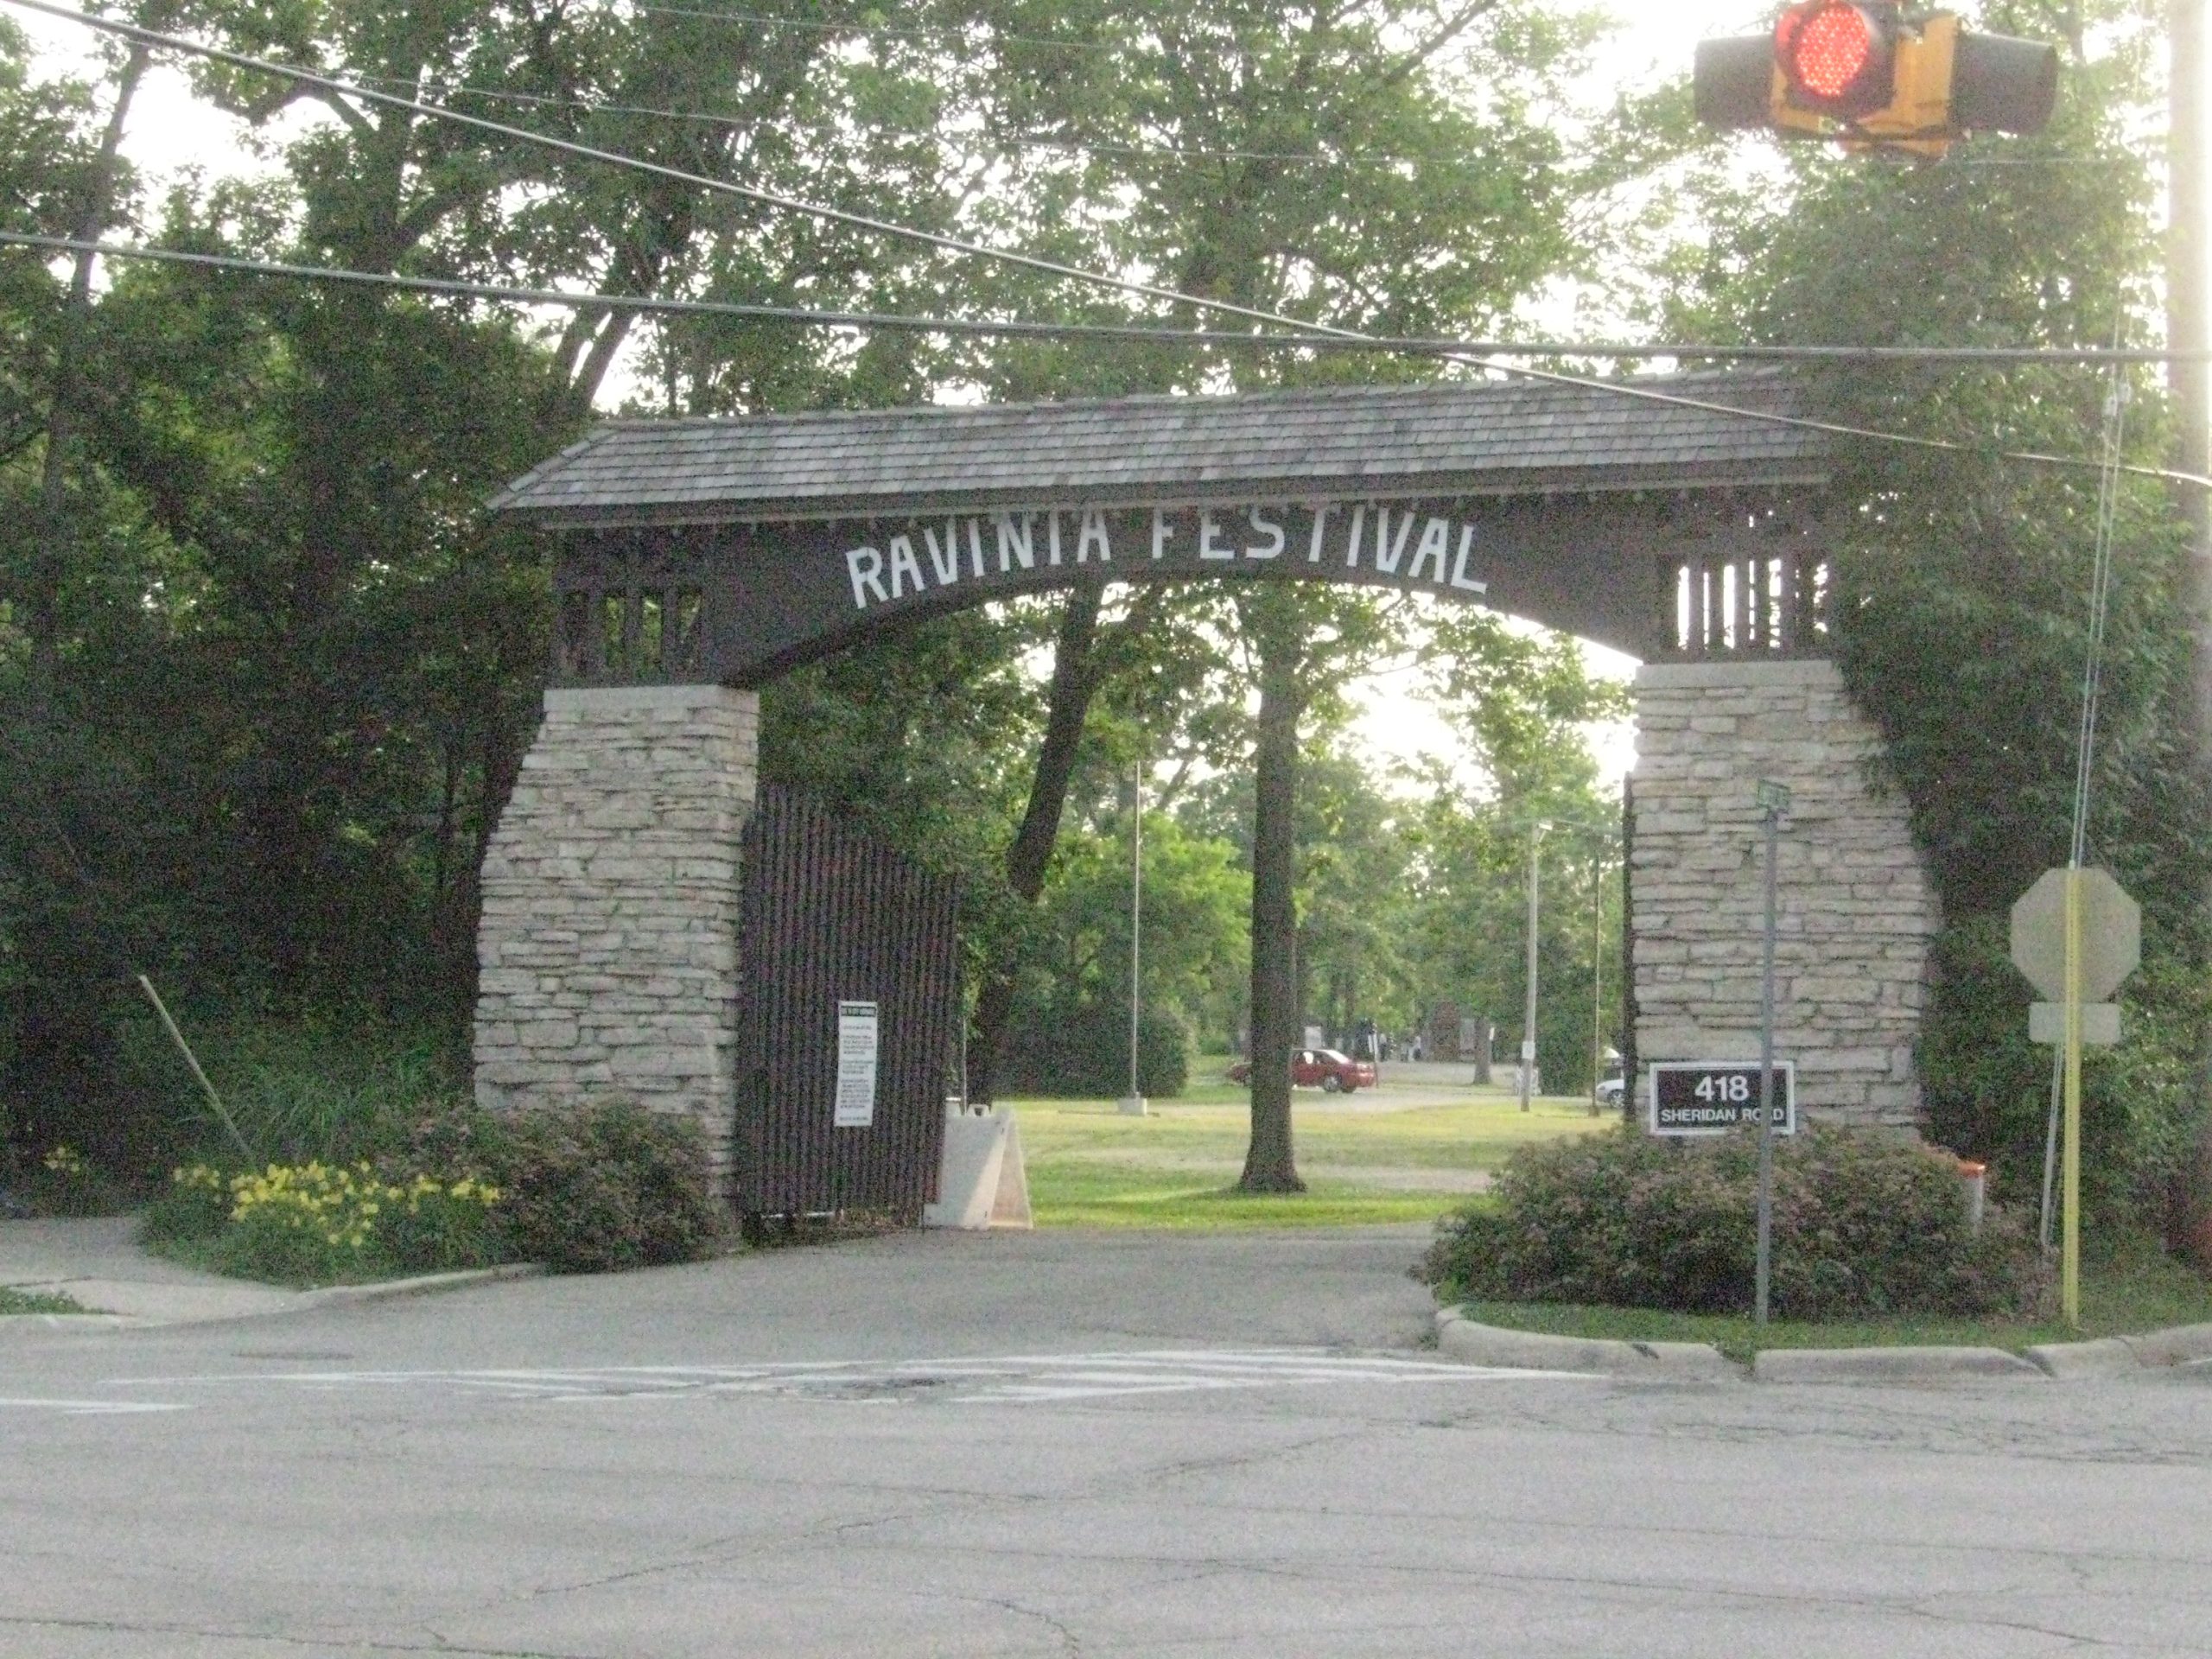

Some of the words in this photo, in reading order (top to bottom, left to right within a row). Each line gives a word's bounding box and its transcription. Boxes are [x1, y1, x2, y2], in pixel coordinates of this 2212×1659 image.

[845, 505, 1111, 608] RAVINIA
[1151, 504, 1487, 594] FESTIVAL
[1694, 1075, 1750, 1102] 418
[1662, 1109, 1736, 1122] SHERIDAN
[1741, 1108, 1783, 1121] ROD
